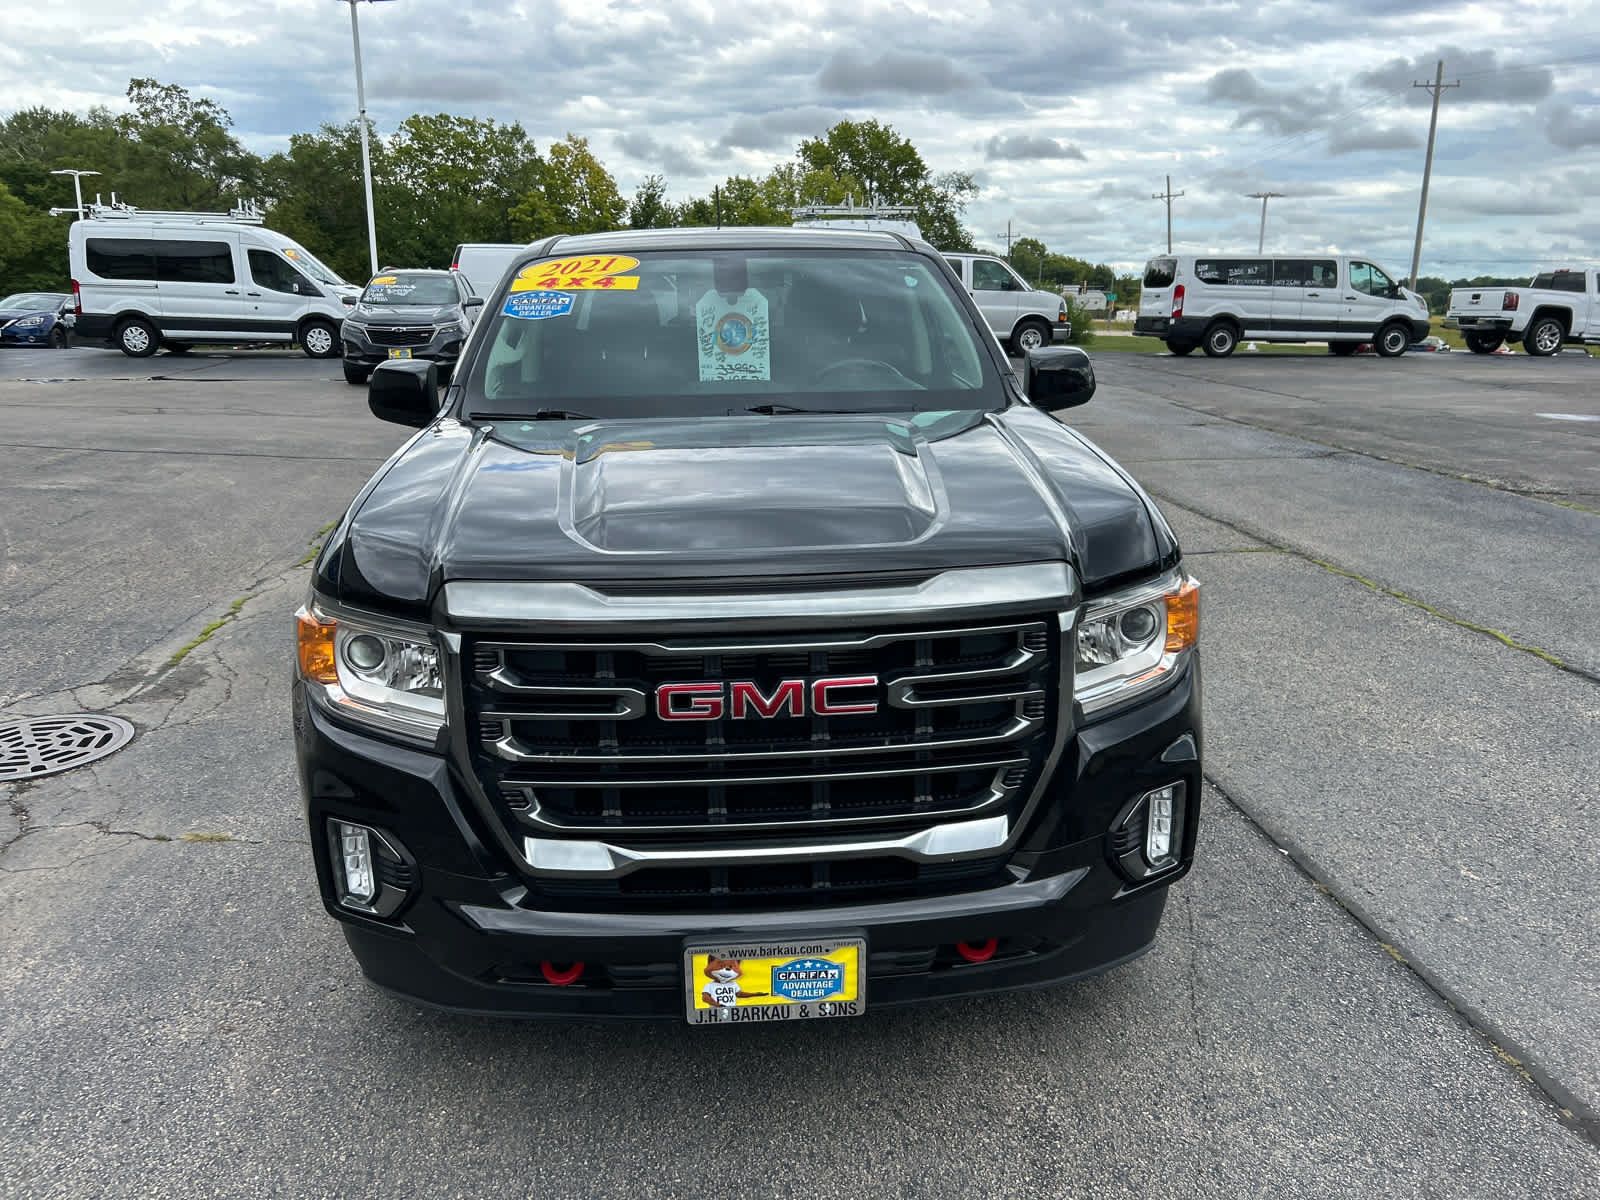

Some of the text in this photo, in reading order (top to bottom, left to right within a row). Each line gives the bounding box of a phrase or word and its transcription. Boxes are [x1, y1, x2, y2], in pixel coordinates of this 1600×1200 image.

[539, 258, 618, 277] 2021
[511, 297, 570, 305] CARFAX
[655, 675, 878, 721] GMC
[728, 944, 823, 959] www.barkau.com
[777, 970, 839, 981] CARFAX
[782, 980, 834, 990] ADVANTAGE
[715, 987, 734, 996] CAR
[791, 989, 825, 998] DEALER
[716, 995, 734, 1003] FOX
[695, 1002, 857, 1024] J.H. BARKAU & SONS
